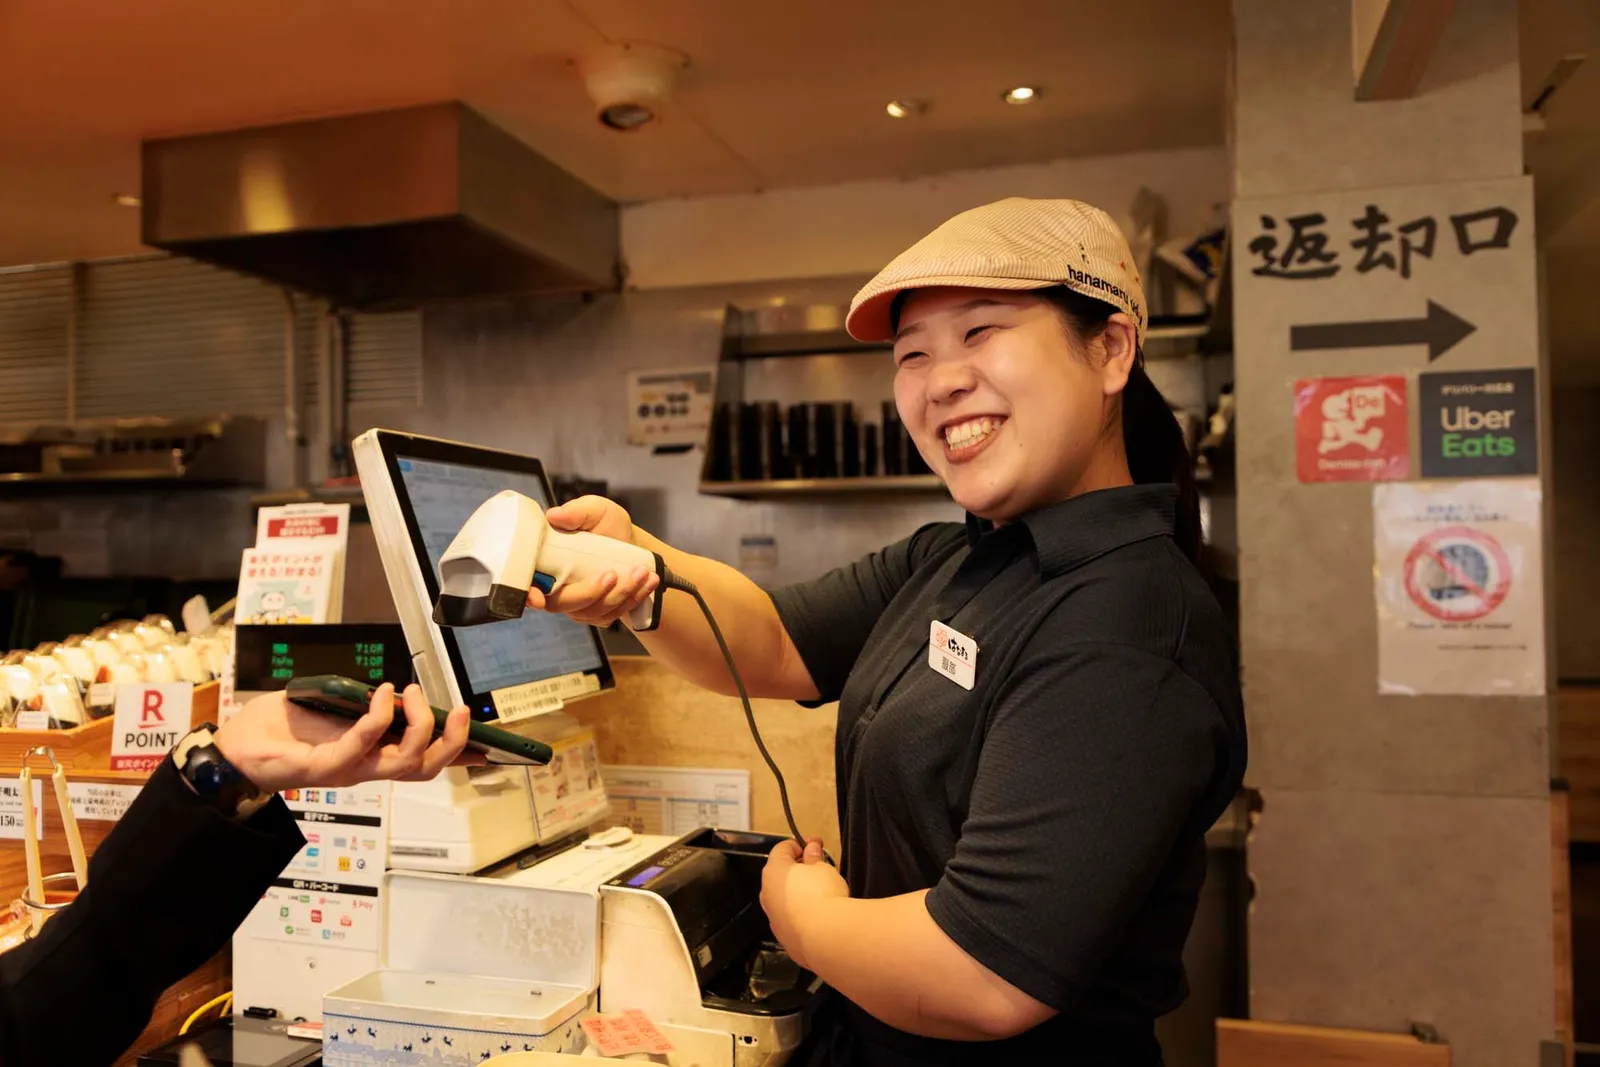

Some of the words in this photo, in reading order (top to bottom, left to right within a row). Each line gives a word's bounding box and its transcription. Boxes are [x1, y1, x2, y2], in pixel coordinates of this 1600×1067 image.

[1248, 204, 1519, 279] 返却口
[1067, 264, 1129, 304] hanamaru
[1441, 405, 1515, 431] Uber
[1442, 433, 1515, 458] Eats
[143, 690, 165, 721] R
[125, 732, 178, 748] POINT
